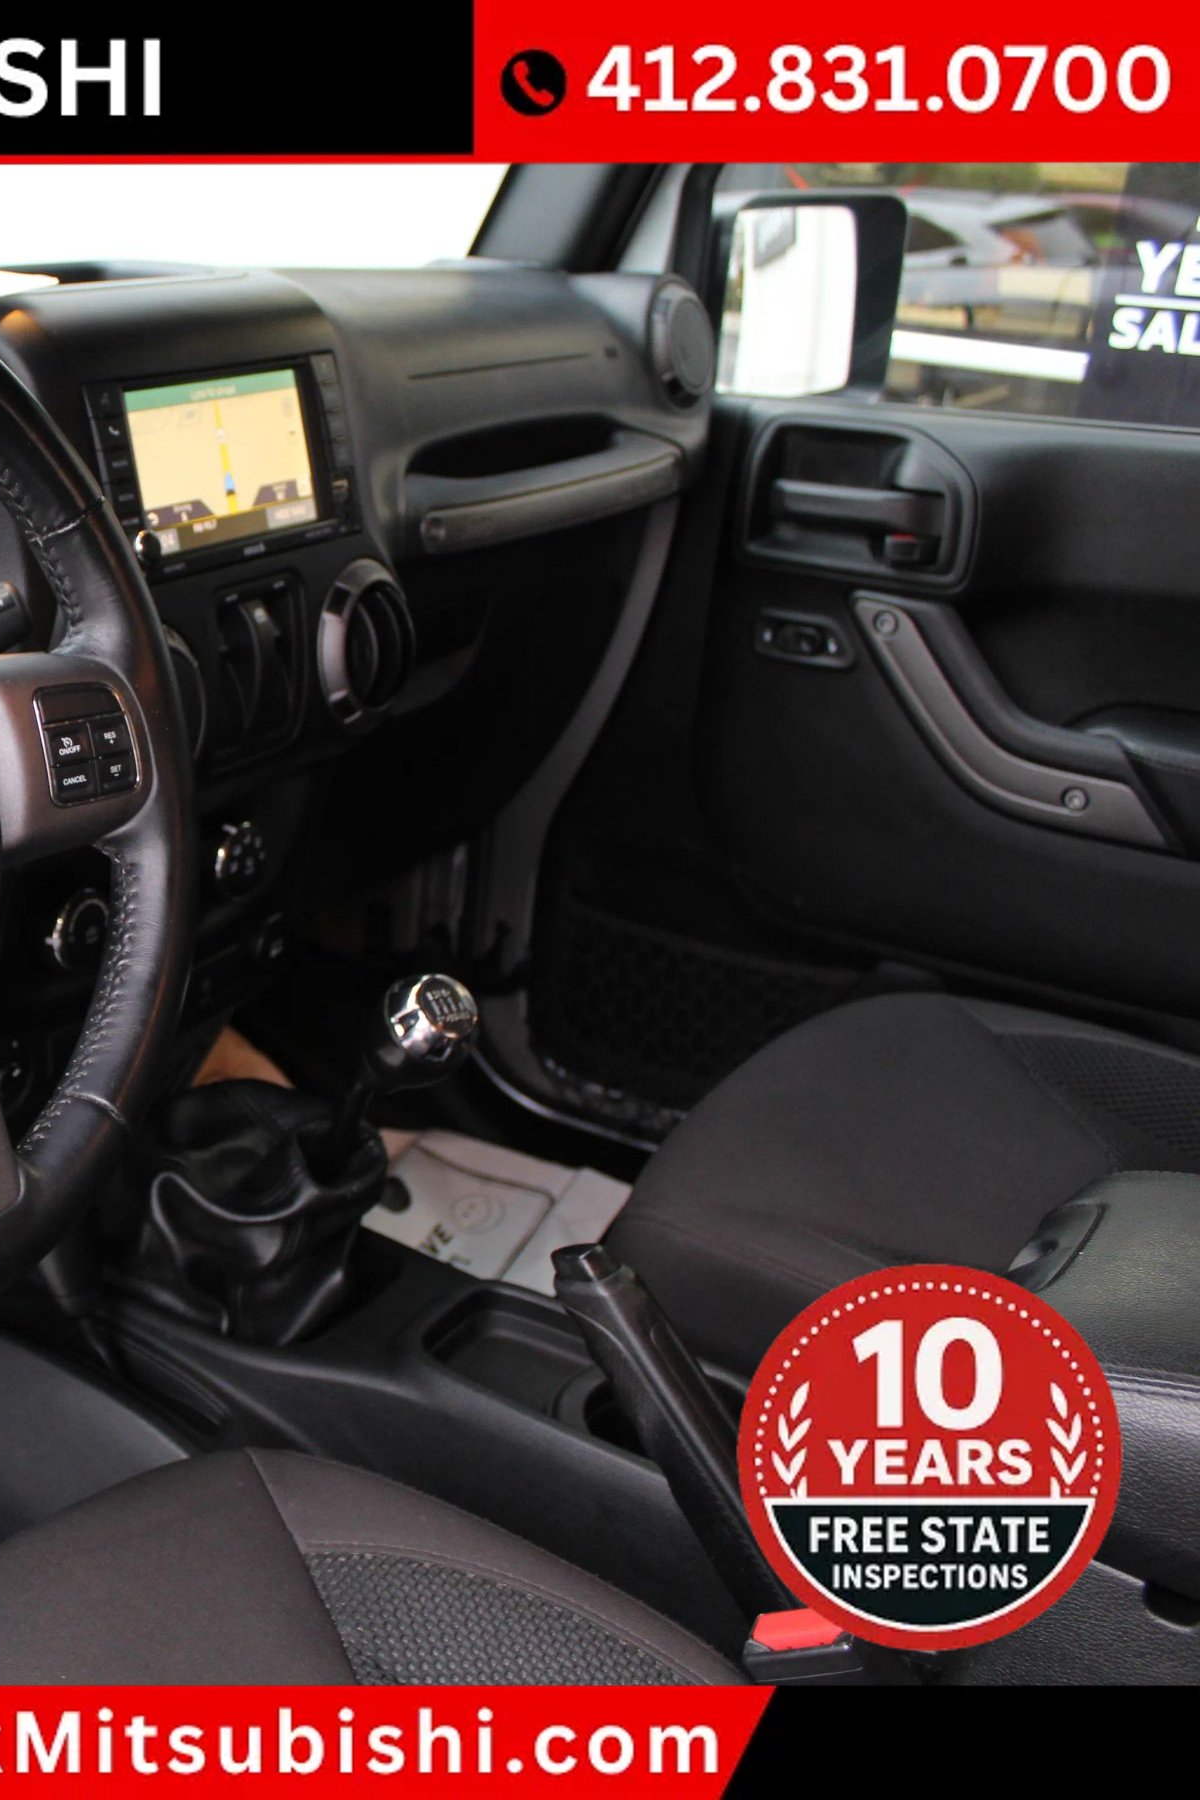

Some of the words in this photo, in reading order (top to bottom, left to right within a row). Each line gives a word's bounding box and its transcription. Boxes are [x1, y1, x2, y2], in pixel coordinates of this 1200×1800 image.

[103, 731, 117, 740] RES
[58, 744, 81, 756] ON/OFF
[110, 764, 122, 773] SET
[62, 774, 87, 786] CANCEL
